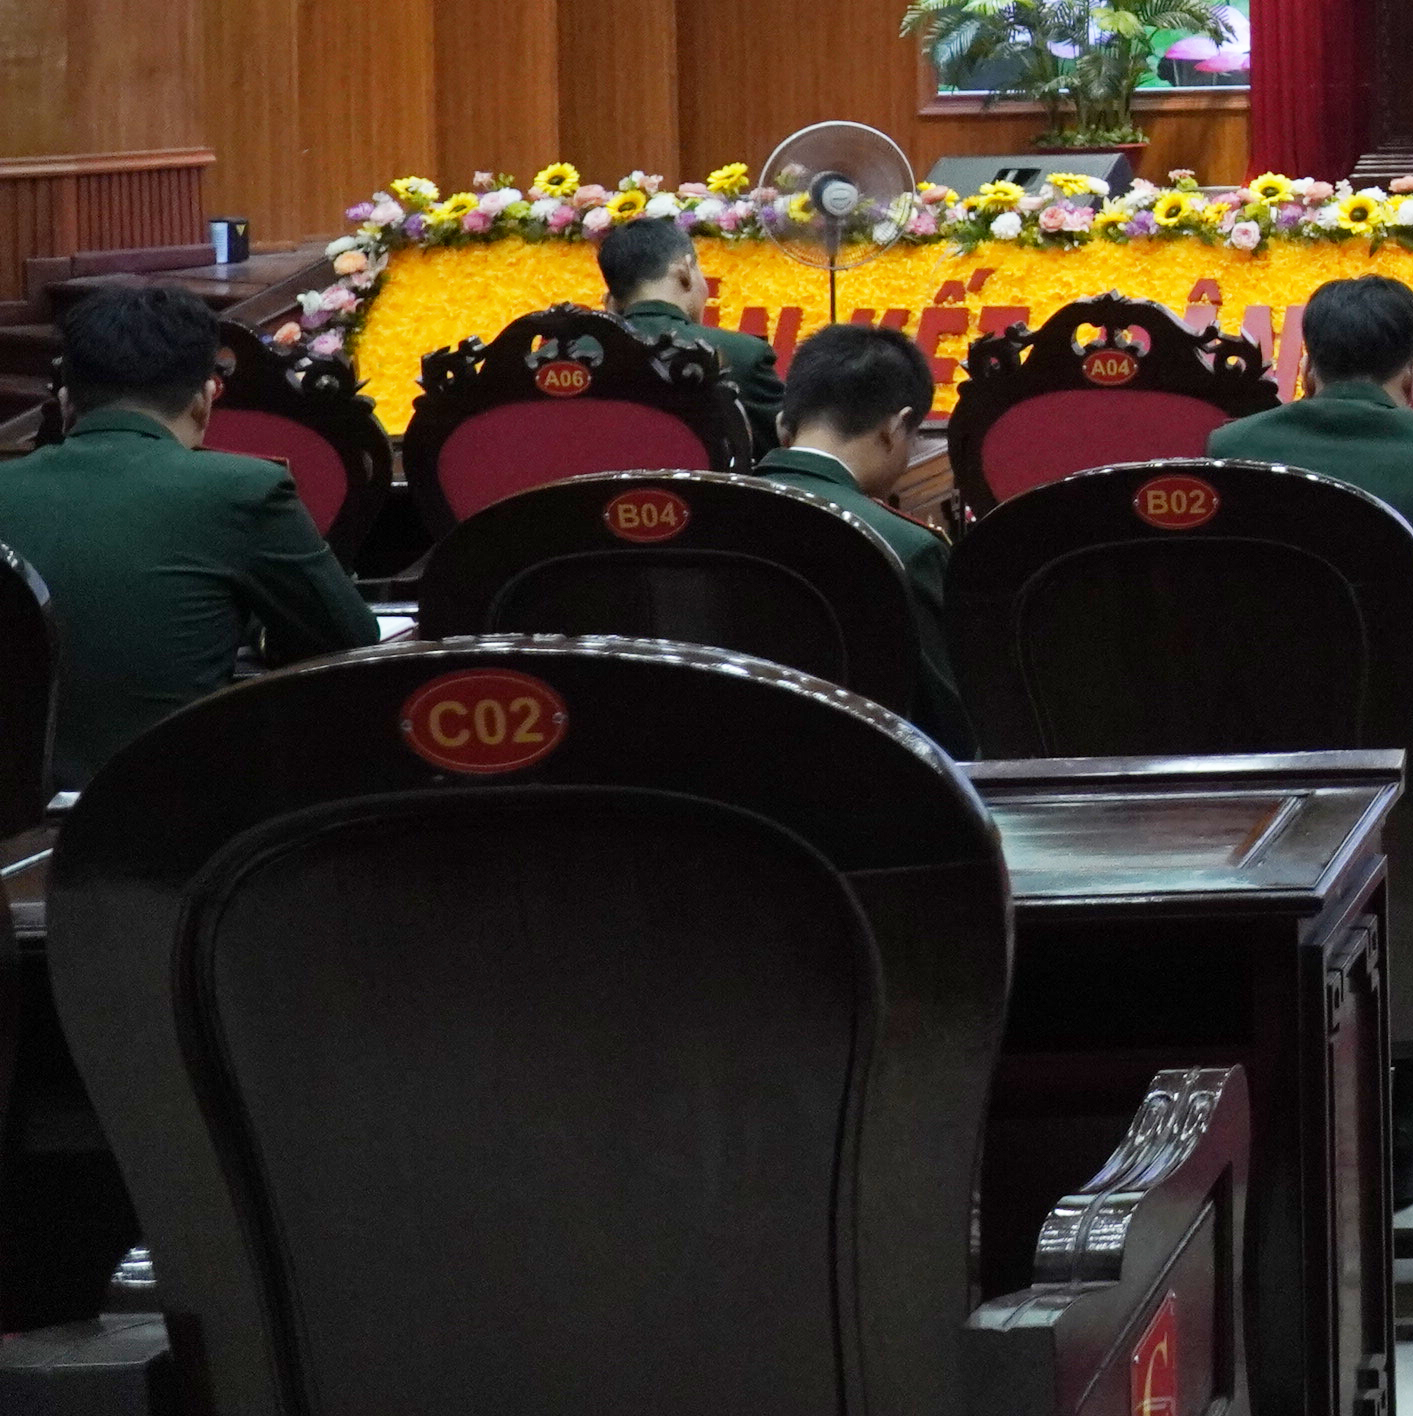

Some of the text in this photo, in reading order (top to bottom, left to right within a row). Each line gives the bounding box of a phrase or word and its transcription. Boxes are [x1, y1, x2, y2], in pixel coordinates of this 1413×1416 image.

[544, 369, 584, 387] A06
[1091, 358, 1130, 376] A04
[1147, 490, 1206, 514] B02
[618, 503, 678, 528] B04
[428, 697, 543, 748] C02
